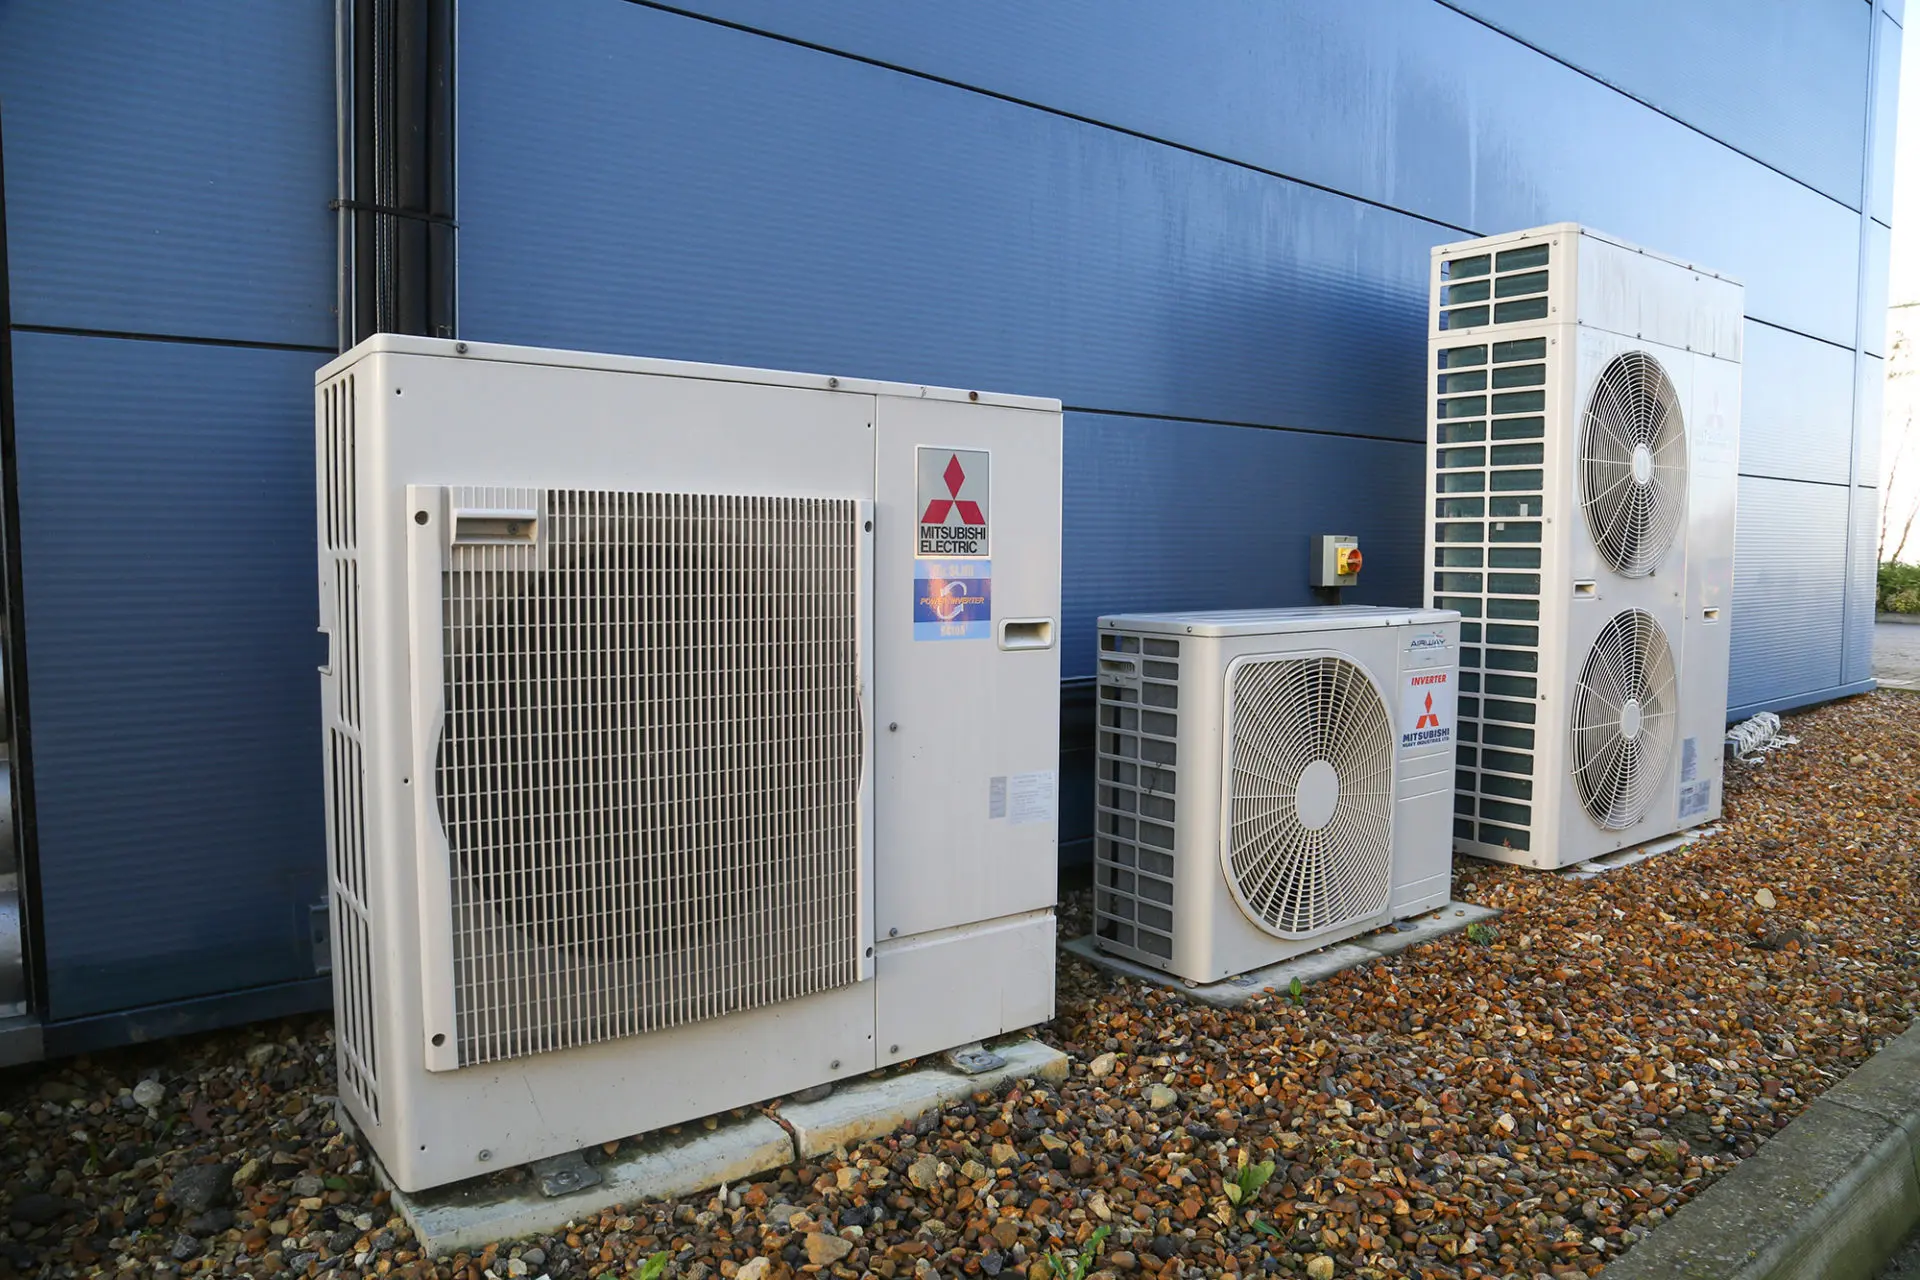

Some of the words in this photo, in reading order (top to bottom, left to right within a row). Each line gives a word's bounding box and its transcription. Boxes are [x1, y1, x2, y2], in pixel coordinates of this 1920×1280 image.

[921, 526, 986, 540] MITSUBISHI
[921, 541, 978, 553] ELECTRIC
[951, 597, 985, 605] INVERTER
[1410, 639, 1446, 648] AIRWAY
[1411, 674, 1447, 686] INVERTER
[1402, 728, 1450, 743] MITSUBISHI
